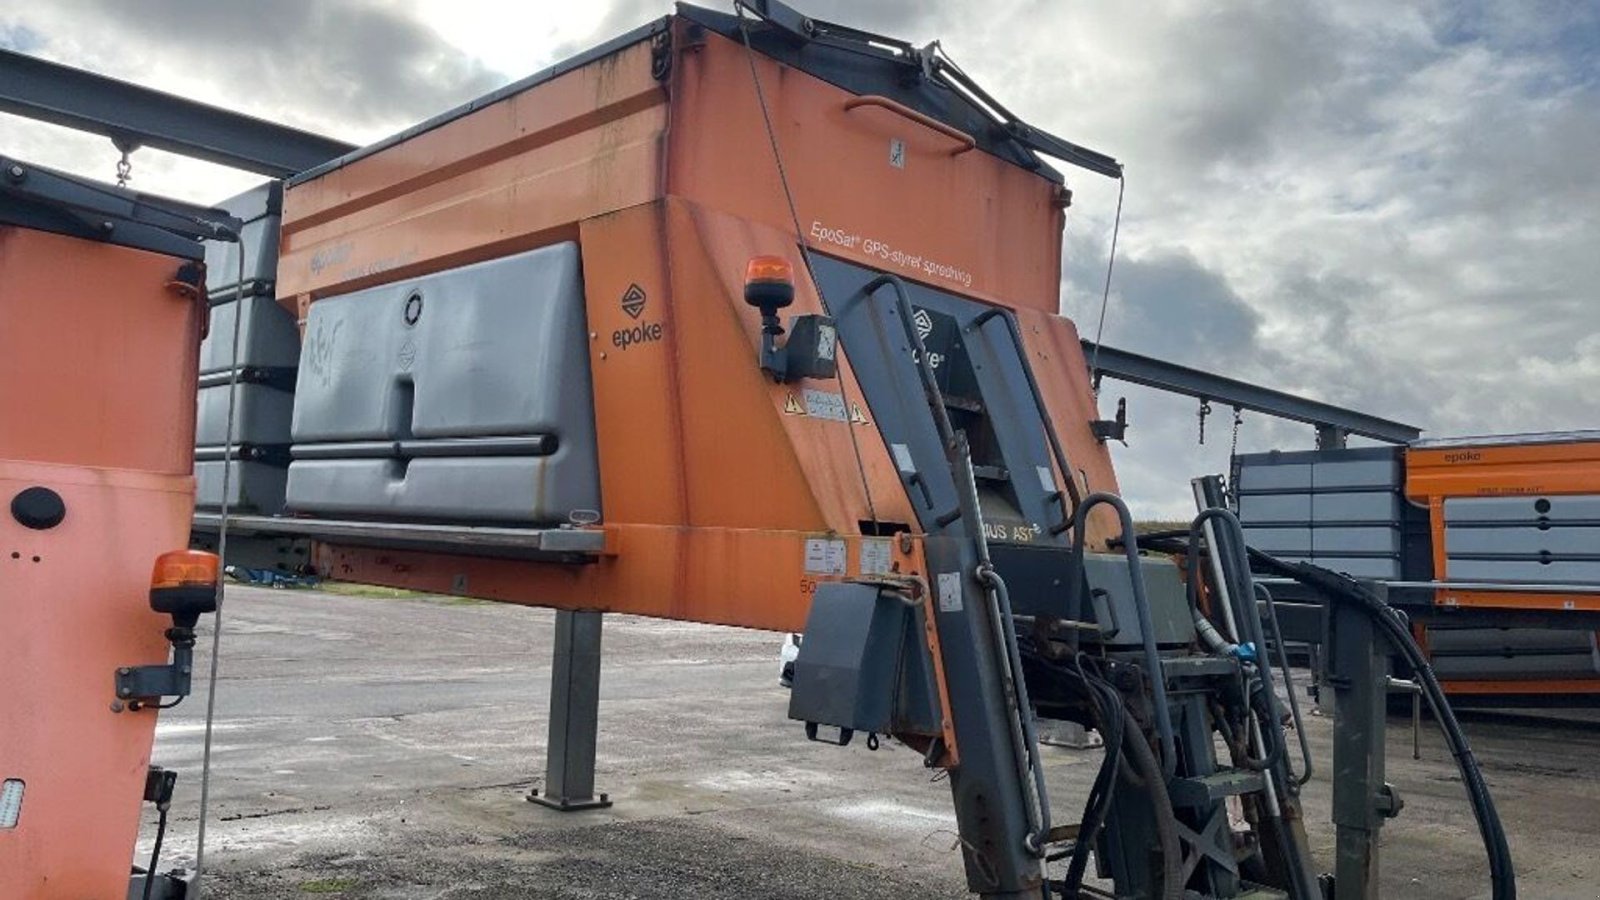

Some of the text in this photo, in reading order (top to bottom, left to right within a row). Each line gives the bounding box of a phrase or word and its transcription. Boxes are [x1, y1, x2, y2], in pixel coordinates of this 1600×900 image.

[862, 238, 921, 268] GPS-styret
[923, 259, 972, 287] spredning
[612, 320, 662, 351] epoke
